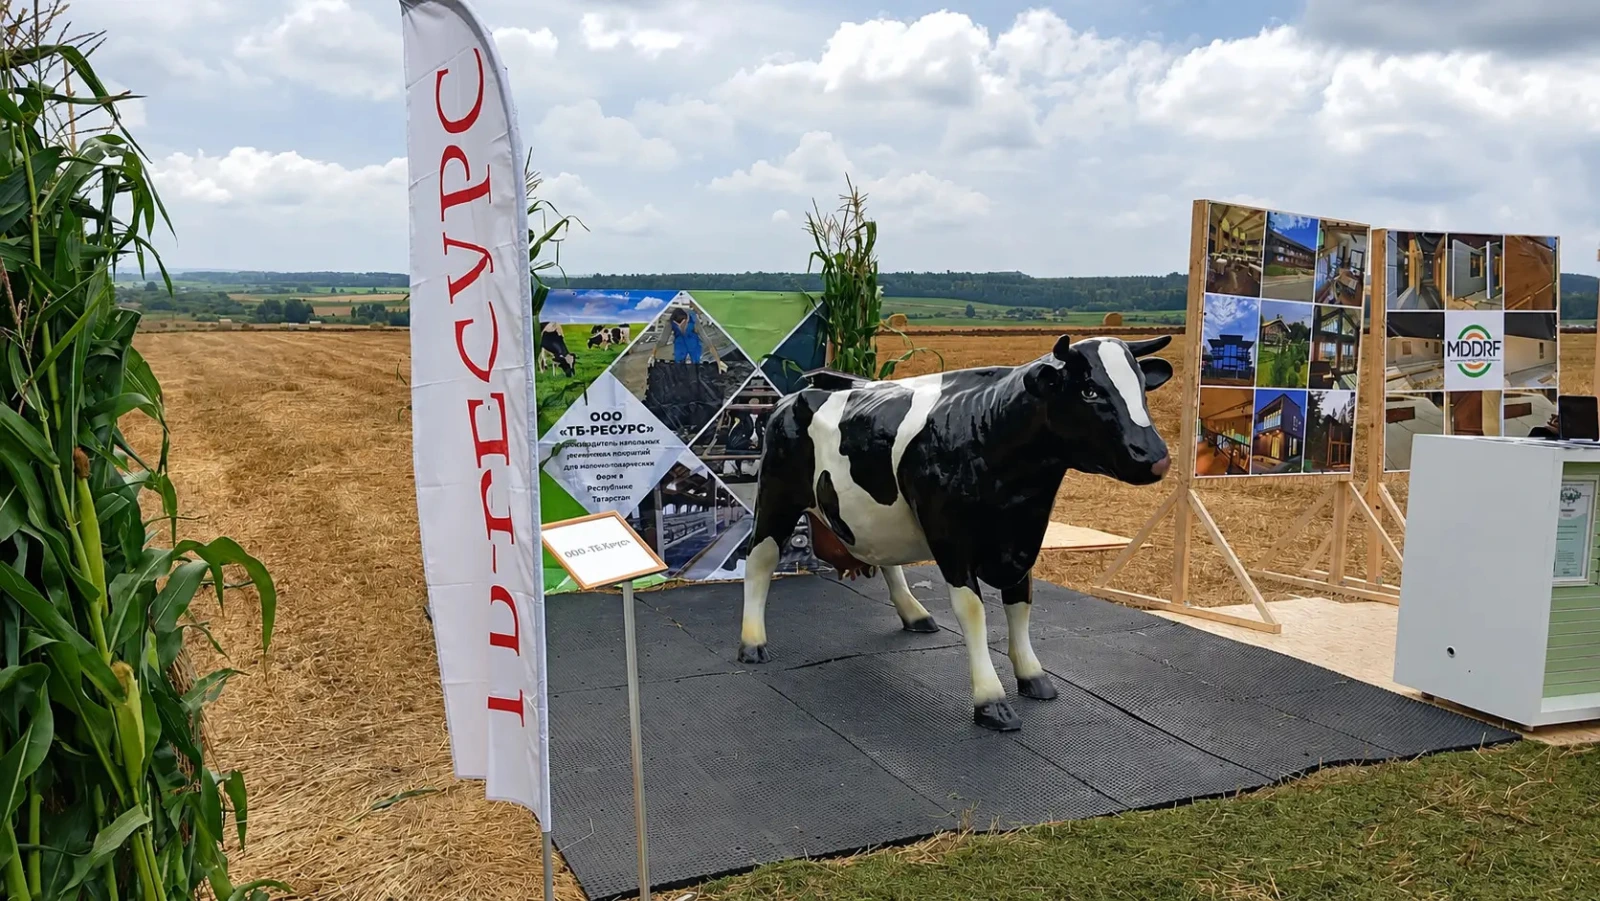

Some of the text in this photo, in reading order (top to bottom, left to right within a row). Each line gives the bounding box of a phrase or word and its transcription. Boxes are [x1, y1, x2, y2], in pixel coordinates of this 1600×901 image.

[1447, 340, 1502, 357] MDDRF
[590, 411, 623, 422] ООО
[559, 423, 654, 436] «ТБ-РЕСУРС»
[562, 440, 618, 449] роизводитель
[587, 484, 633, 493] Республике
